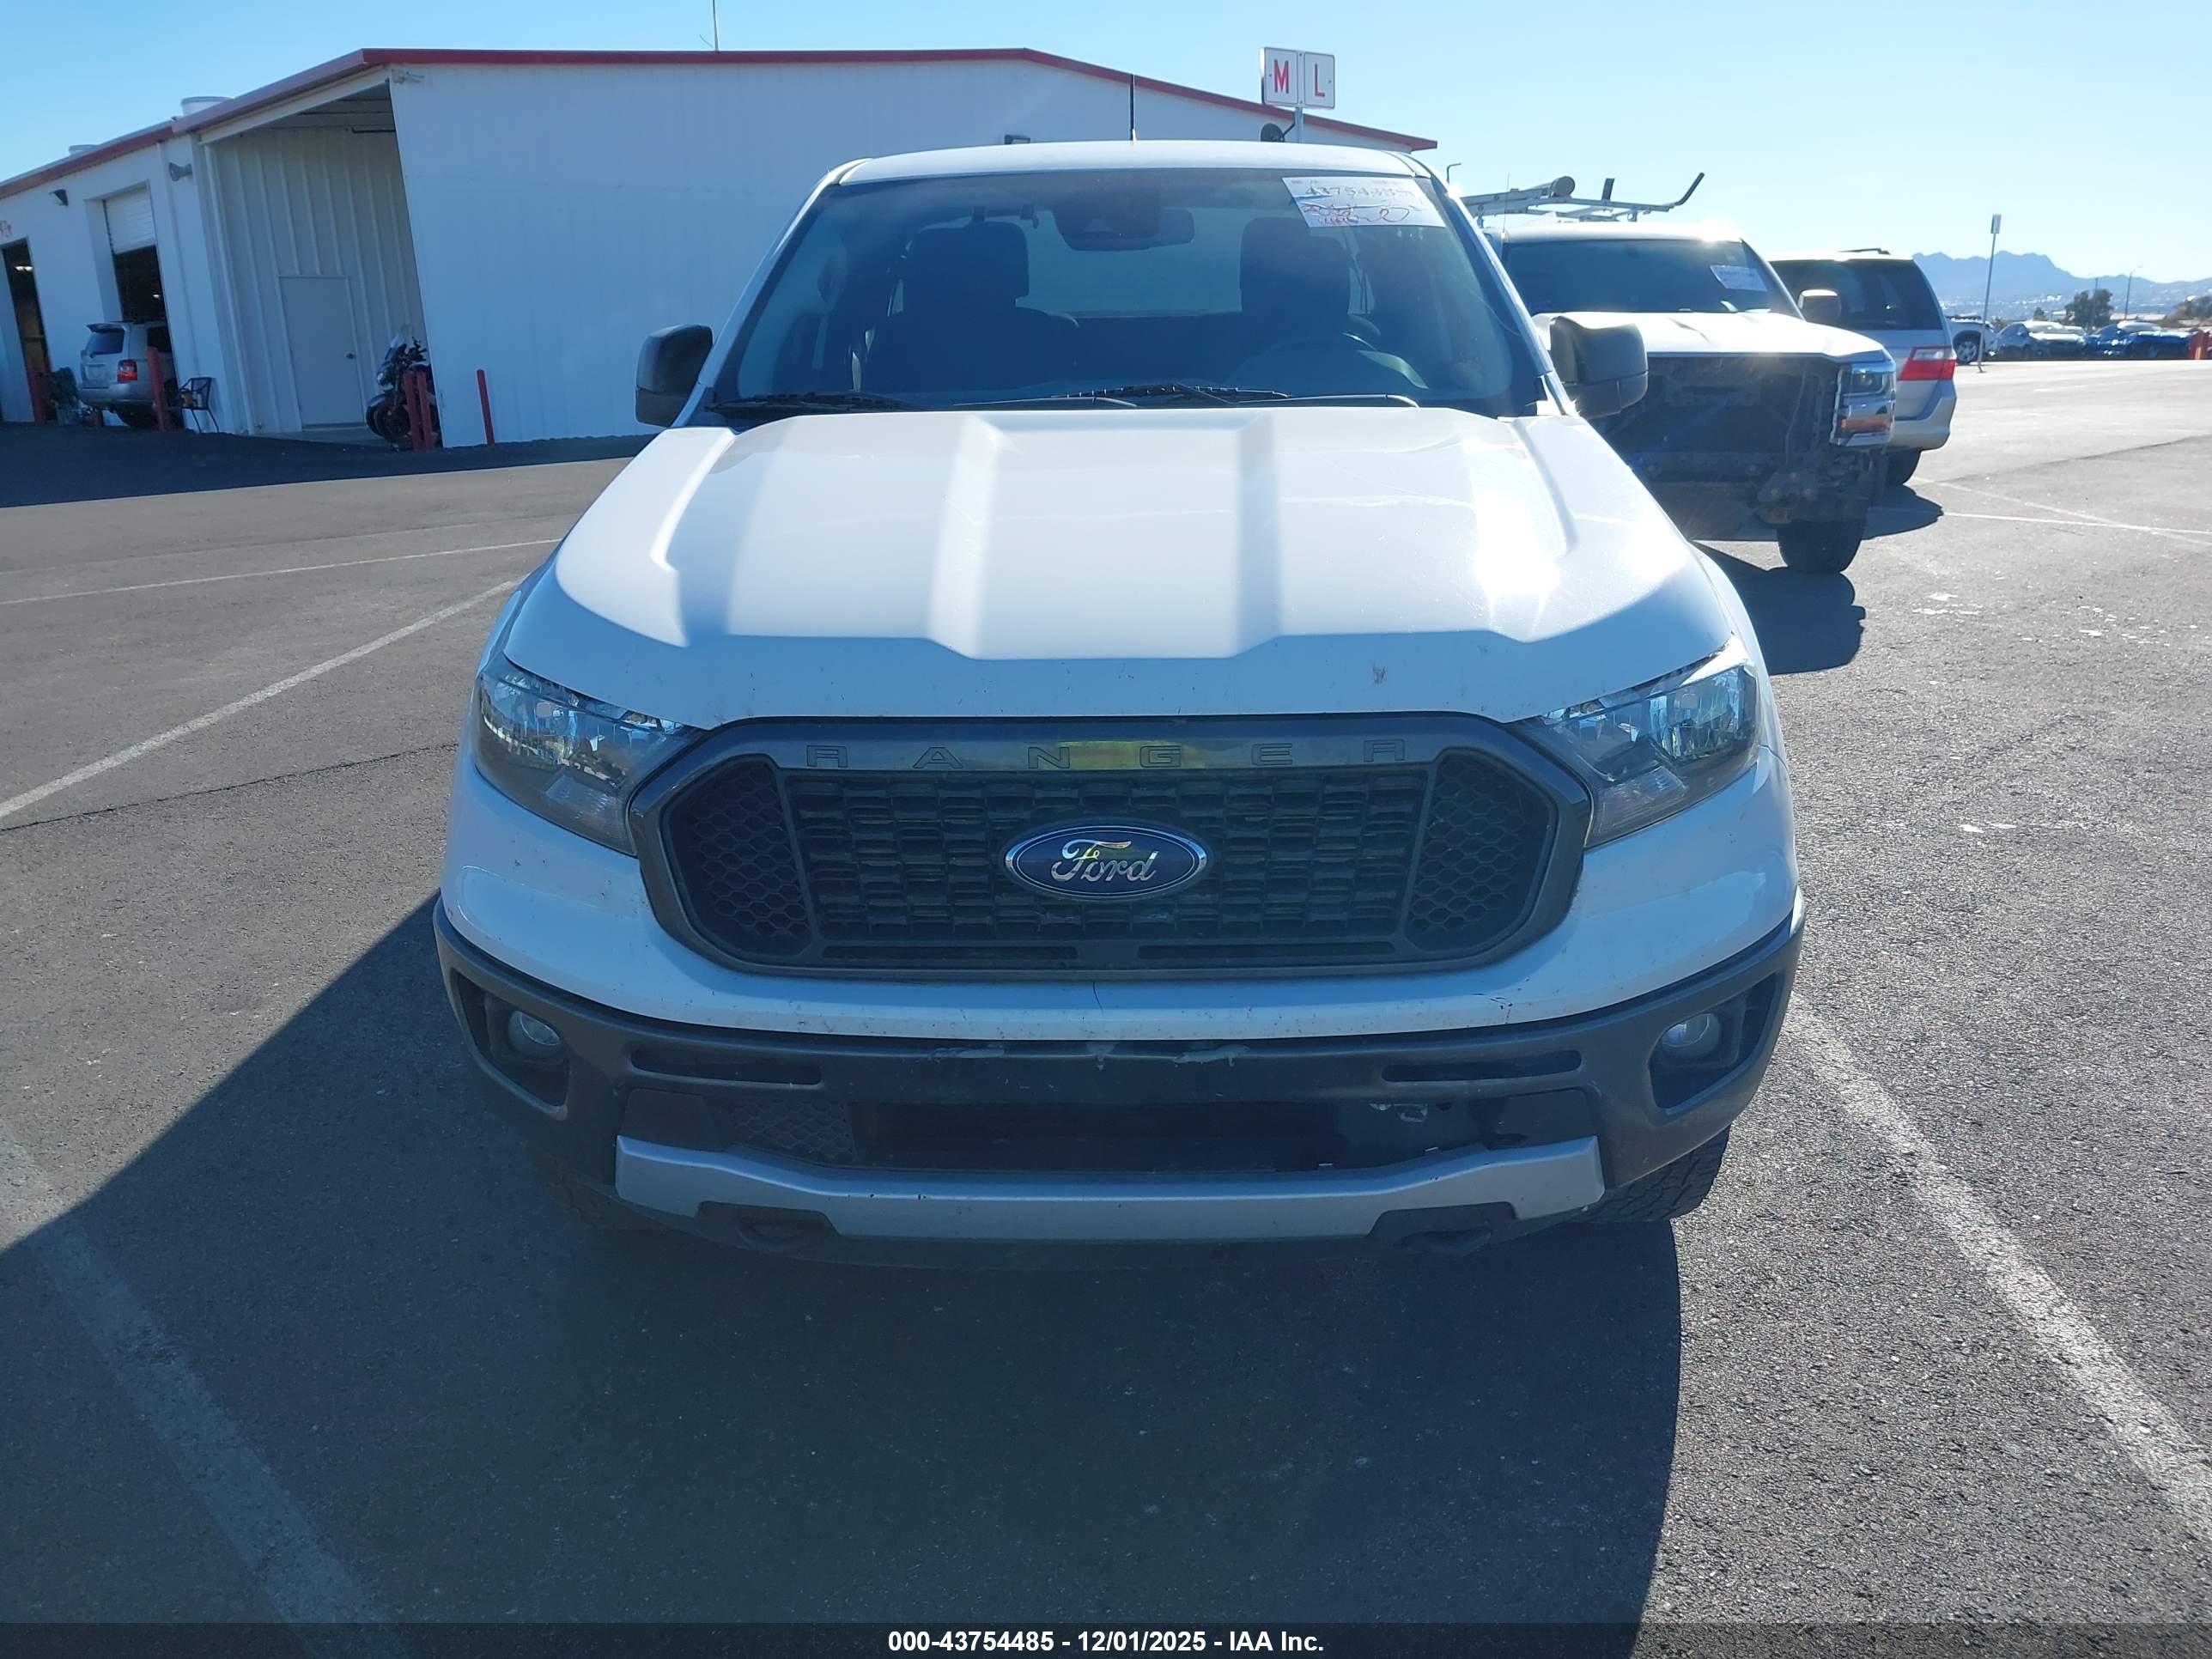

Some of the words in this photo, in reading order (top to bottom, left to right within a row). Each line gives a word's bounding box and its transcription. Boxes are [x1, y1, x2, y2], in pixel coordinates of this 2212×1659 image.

[1273, 58, 1289, 94] M
[1315, 63, 1325, 97] L
[806, 738, 1406, 769] RANGER
[1050, 838, 1159, 882] Ford
